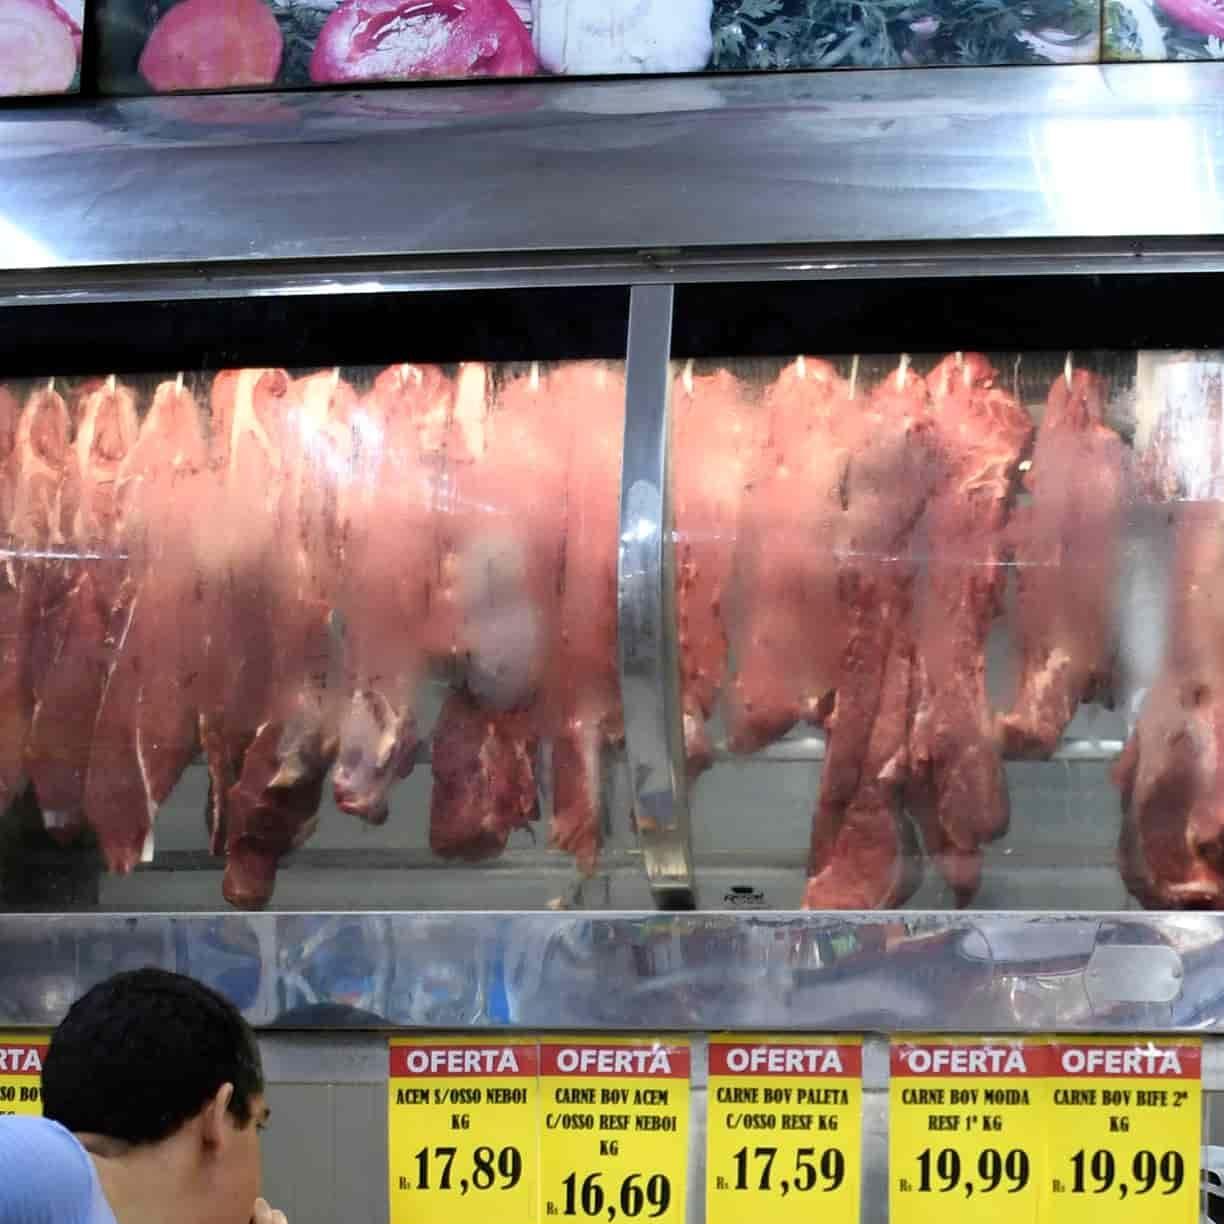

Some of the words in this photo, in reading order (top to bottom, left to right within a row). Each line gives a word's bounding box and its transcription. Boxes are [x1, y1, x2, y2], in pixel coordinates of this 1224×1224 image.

[407, 1049, 519, 1073] OFERTA
[557, 1049, 671, 1074] OFERTA
[726, 1048, 843, 1073] OFERTA
[907, 1049, 1027, 1073] OFERTA
[1062, 1049, 1182, 1074] OFERTA
[21, 1087, 43, 1101] BO
[396, 1088, 429, 1104] ACEM
[434, 1088, 481, 1104] S/OSSO
[486, 1088, 527, 1104] NEBOI
[555, 1088, 596, 1104] CARNE
[600, 1088, 629, 1105] BOV
[633, 1090, 668, 1105] ACEM
[716, 1087, 758, 1104] CARNE
[764, 1088, 792, 1104] BOV
[797, 1089, 848, 1105] PALETA
[902, 1089, 945, 1105] CARNE
[950, 1089, 979, 1105] BOV
[984, 1089, 1030, 1105] MOIDA
[1053, 1089, 1096, 1105] CARNE
[1102, 1090, 1130, 1106] BOV
[1136, 1090, 1168, 1107] BIFE
[452, 1114, 470, 1130] KG
[546, 1113, 594, 1130] C/OSSO
[600, 1115, 630, 1130] RESF
[635, 1116, 677, 1132] NEBOI
[726, 1113, 776, 1129] C/OSSO
[781, 1114, 814, 1130] RESF
[818, 1115, 838, 1130] KG
[928, 1115, 960, 1131] RESF
[983, 1115, 1002, 1131] KG
[1109, 1116, 1129, 1132] KG
[600, 1140, 618, 1156] KG
[415, 1146, 522, 1195] 17,89
[733, 1147, 845, 1197] 17,59
[916, 1148, 1030, 1198] 19,99
[1070, 1149, 1184, 1200] 19,99
[562, 1172, 671, 1222] 16,69
